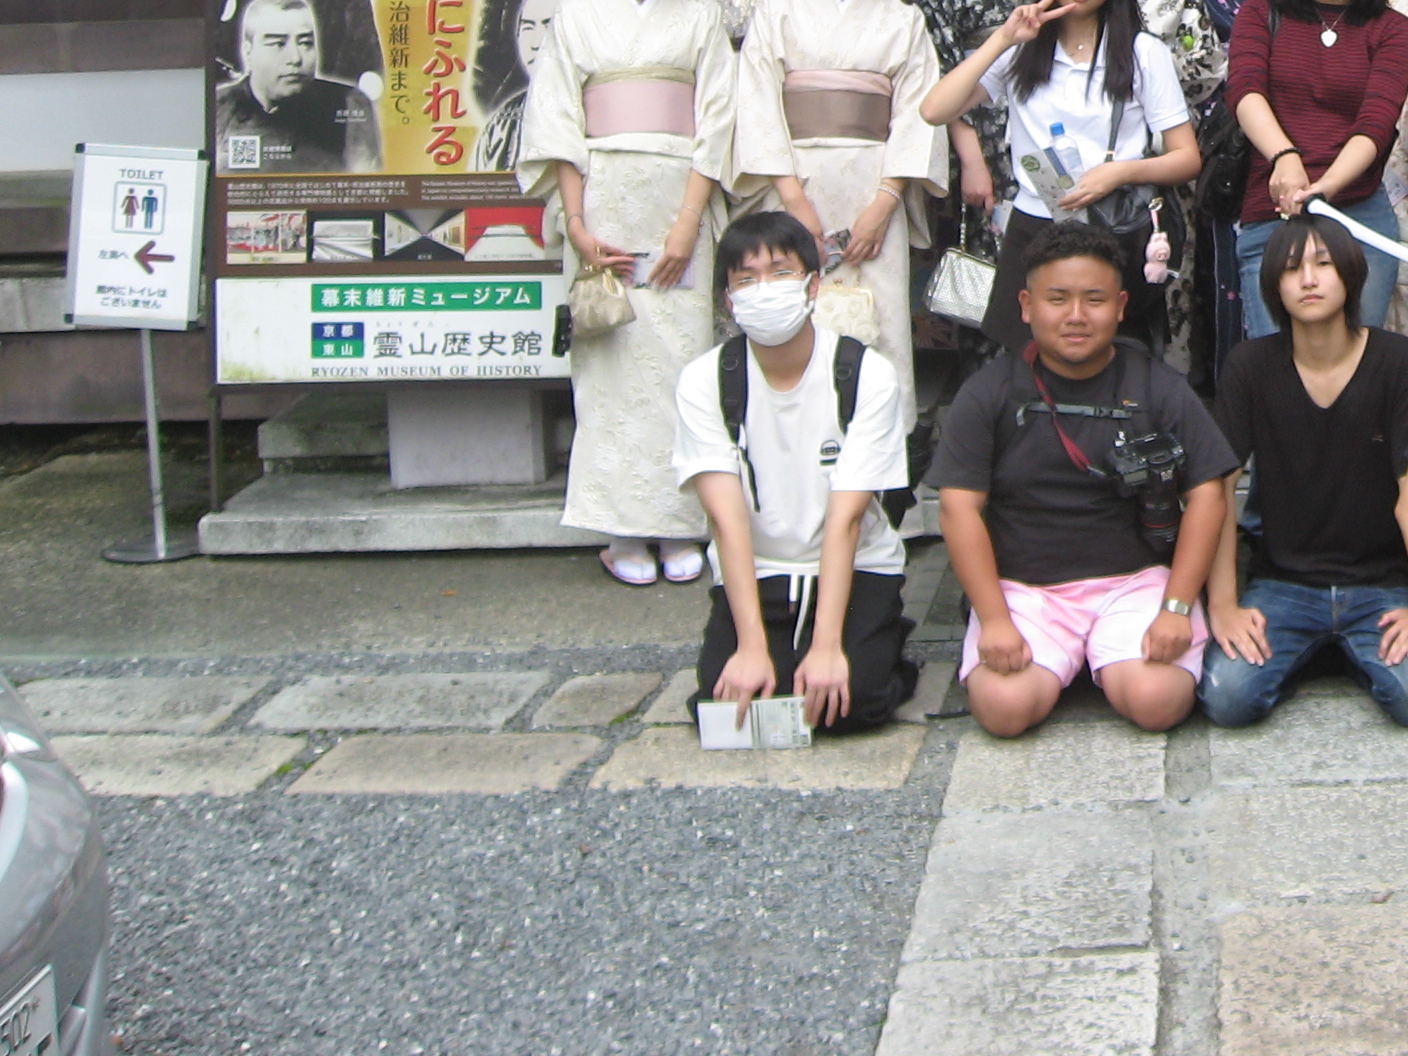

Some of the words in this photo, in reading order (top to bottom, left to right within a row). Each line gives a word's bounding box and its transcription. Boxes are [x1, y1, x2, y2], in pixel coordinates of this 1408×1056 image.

[119, 168, 164, 181] TOILET
[101, 296, 162, 309] ございません
[321, 287, 531, 308] 幕末維新ミュージアム
[322, 324, 354, 337] 京都
[321, 343, 353, 356] 東山
[373, 330, 542, 358] 霊山歴史館
[311, 366, 369, 377] RYOZEN
[377, 365, 441, 377] MUSEUM
[449, 365, 469, 377] OF
[477, 365, 542, 376] HISTORY
